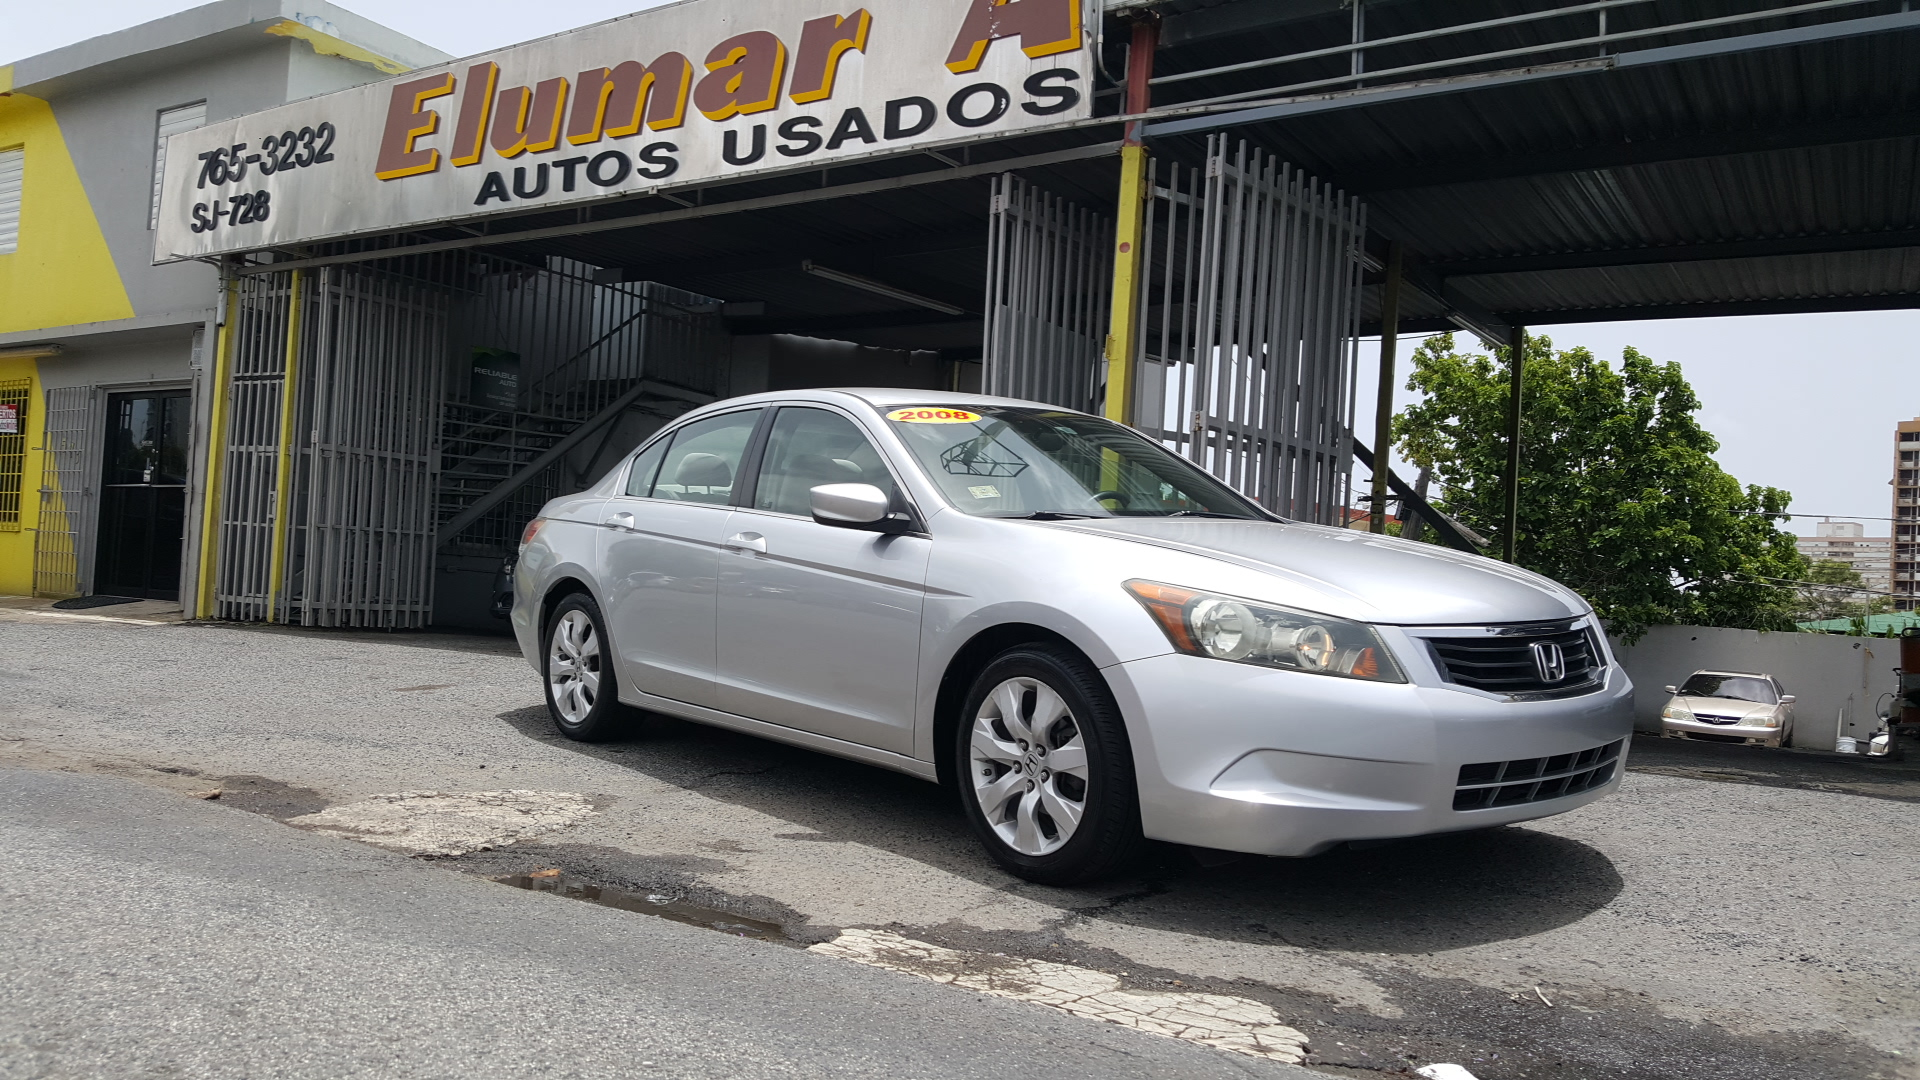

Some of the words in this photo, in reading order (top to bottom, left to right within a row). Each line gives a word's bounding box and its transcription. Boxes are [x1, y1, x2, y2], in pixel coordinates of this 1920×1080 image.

[375, 8, 873, 181] Elumar
[197, 122, 335, 189] 765-3232
[473, 141, 679, 206] AUTOS
[721, 68, 1081, 166] USADOS
[191, 190, 270, 233] SJ-728
[474, 366, 517, 380] RELIABLE
[499, 379, 517, 388] AUTO
[898, 411, 970, 420] 2008
